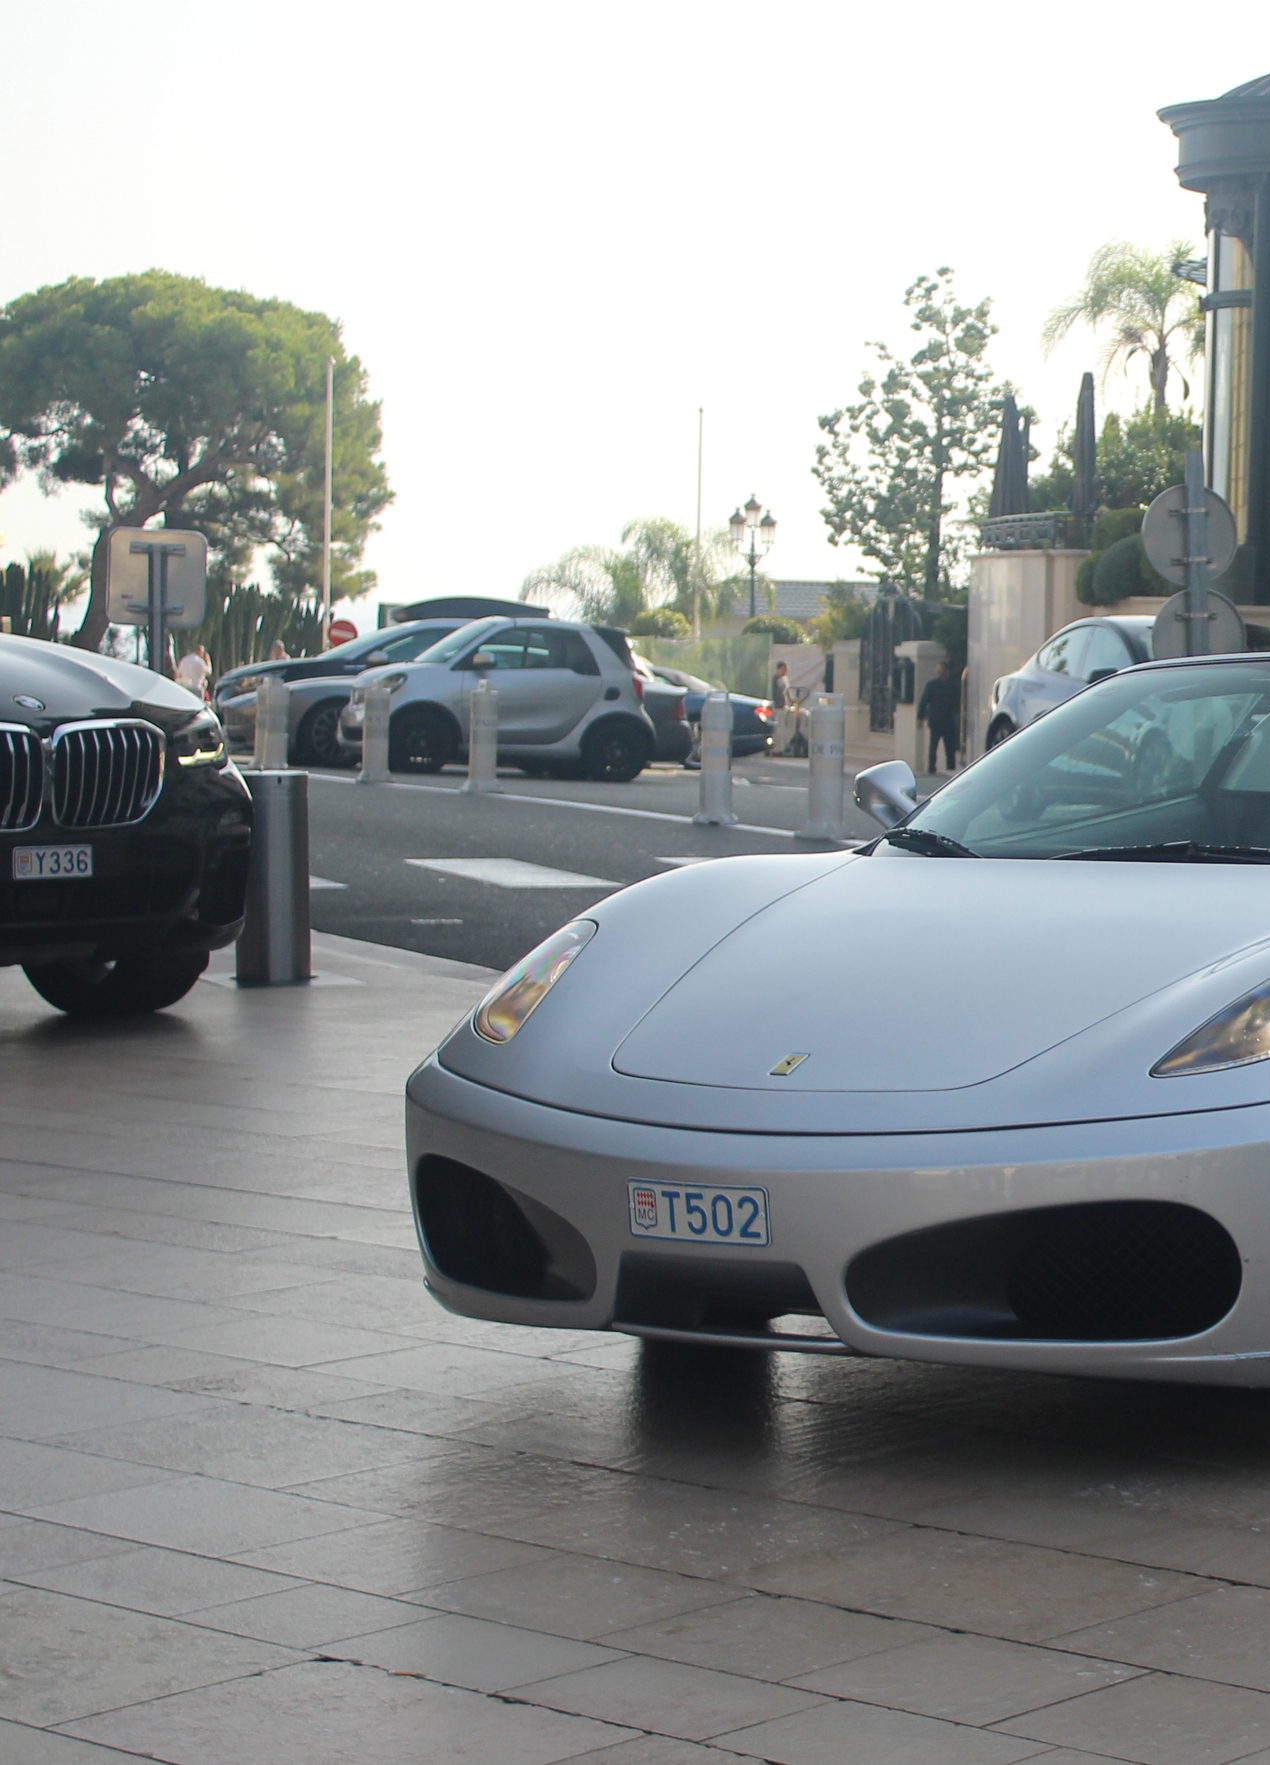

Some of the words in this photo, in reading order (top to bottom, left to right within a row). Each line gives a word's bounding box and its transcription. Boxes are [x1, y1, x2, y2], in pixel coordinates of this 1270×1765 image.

[35, 849, 88, 875] Y336
[638, 1208, 655, 1221] MC
[661, 1190, 762, 1239] T502
